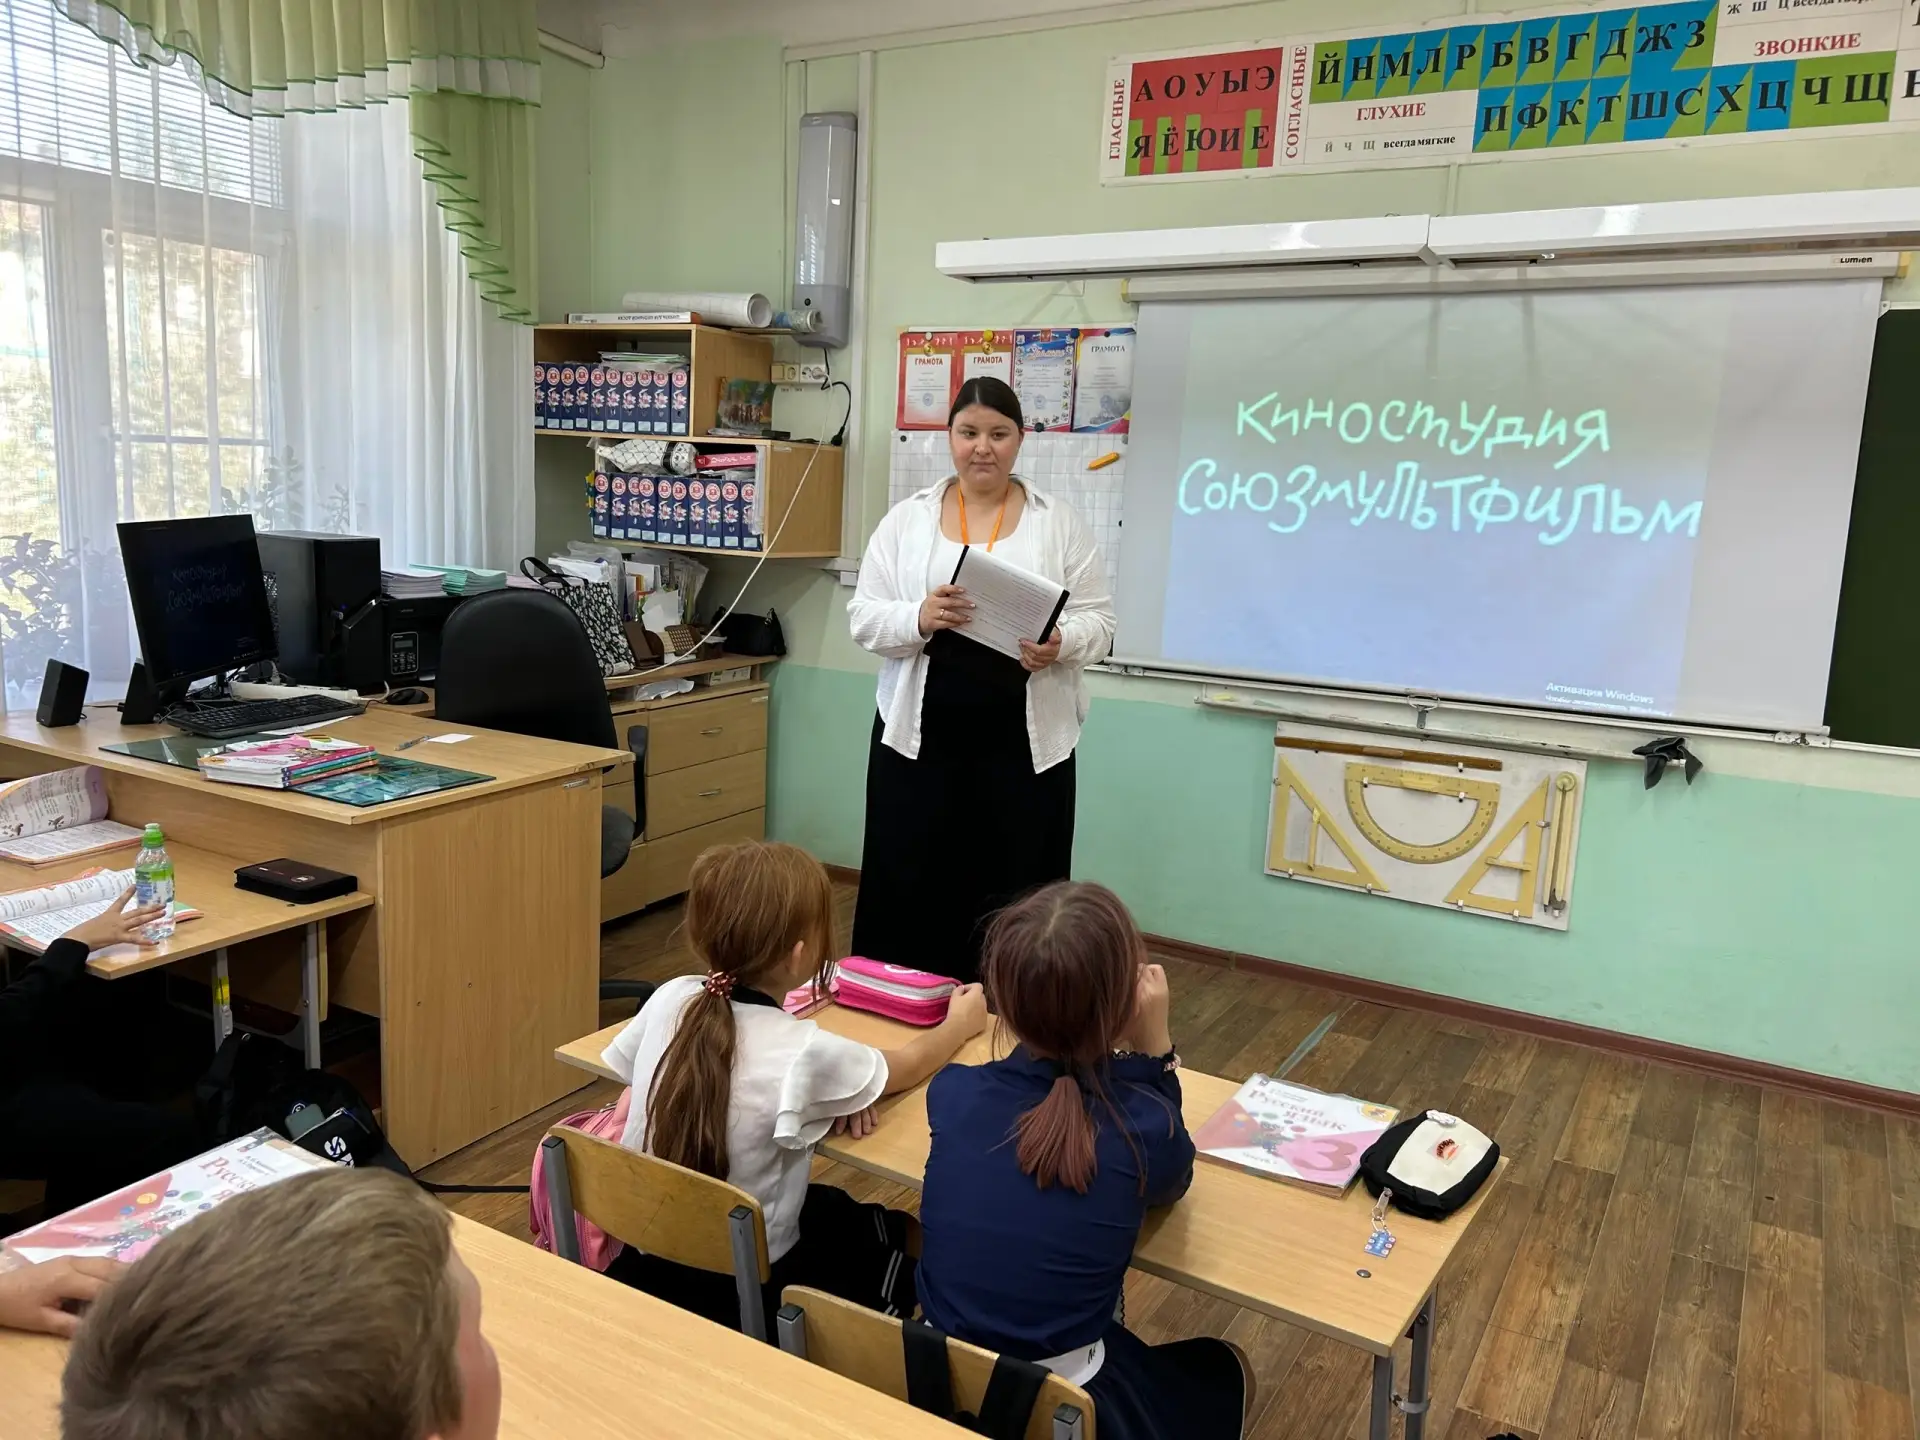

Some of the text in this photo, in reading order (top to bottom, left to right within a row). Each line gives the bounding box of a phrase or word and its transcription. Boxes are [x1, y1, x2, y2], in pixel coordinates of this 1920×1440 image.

[1754, 32, 1861, 57] ЗВОНКИЕ
[1285, 46, 1307, 159] СОГЛАСНЫЕ
[1356, 102, 1426, 121] ГЛУХИЕ
[1109, 79, 1125, 160] ГЛАСНЫЕ
[1383, 138, 1416, 150] всегда
[1417, 134, 1456, 148] мягкие
[1091, 344, 1126, 353] ГРАМОТА
[915, 357, 943, 365] ГРАМОТА
[973, 356, 1003, 364] ГРАМОТА
[1546, 682, 1655, 704] Активация Windows
[1248, 1087, 1325, 1119] Русский
